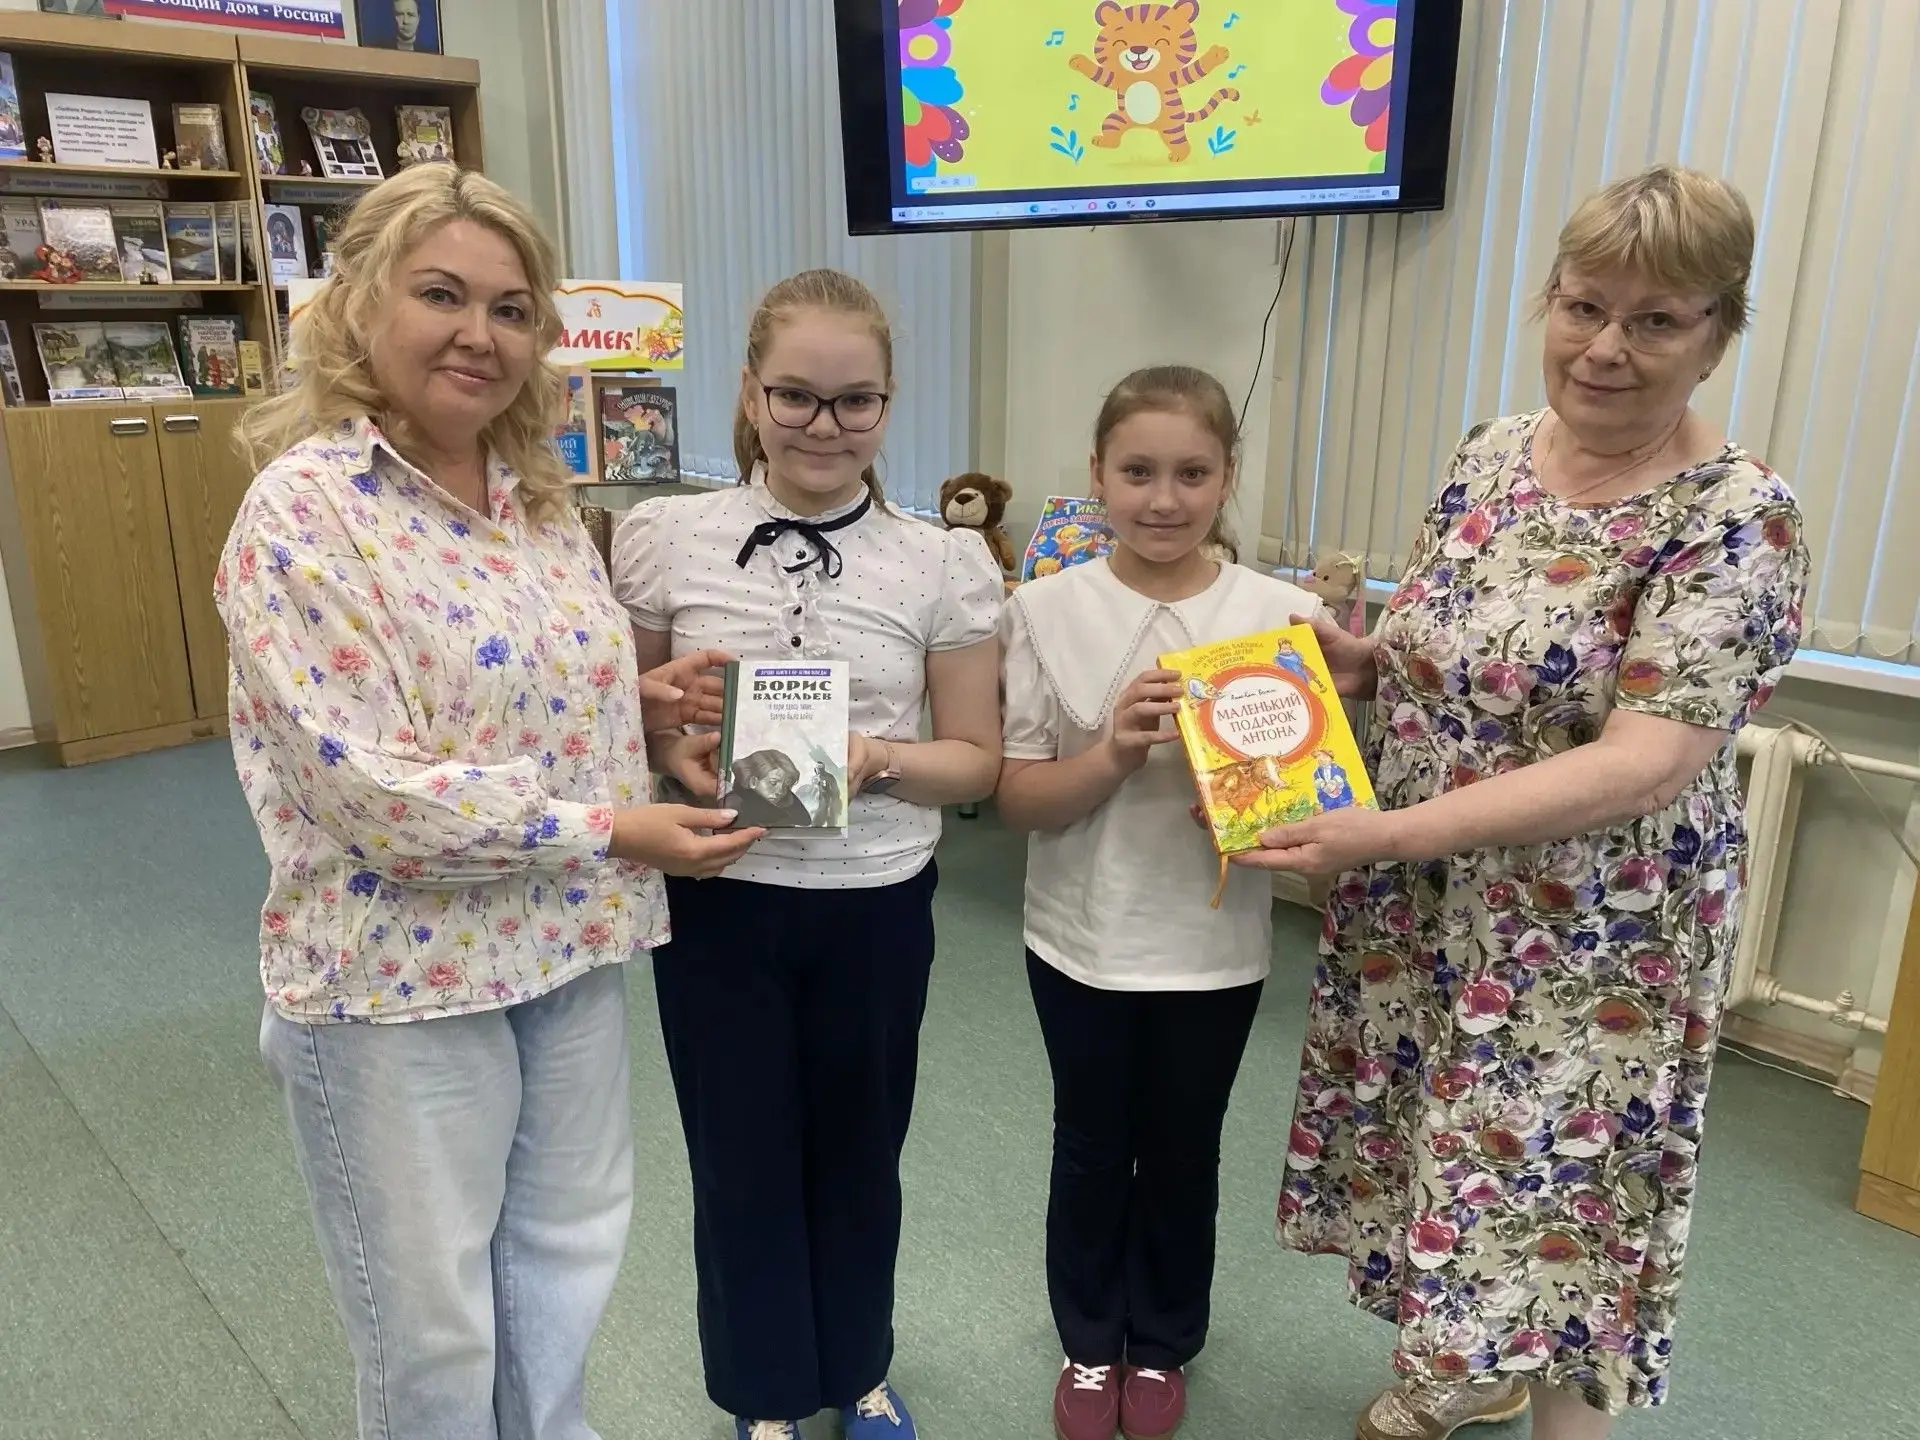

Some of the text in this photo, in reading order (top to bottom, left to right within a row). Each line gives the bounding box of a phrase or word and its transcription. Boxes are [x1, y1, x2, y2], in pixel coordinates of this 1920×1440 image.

[225, 1, 260, 15] дом
[272, 4, 335, 24] Россия!
[1063, 504, 1071, 515] 1
[753, 680, 832, 692] БОРИС
[753, 692, 832, 701] ВАСИЛЬЕВ
[1216, 692, 1302, 722] МАЛЕНЬКИЙ
[1230, 709, 1297, 733] ПОДАРОК
[1241, 724, 1298, 746] АНТОНА
